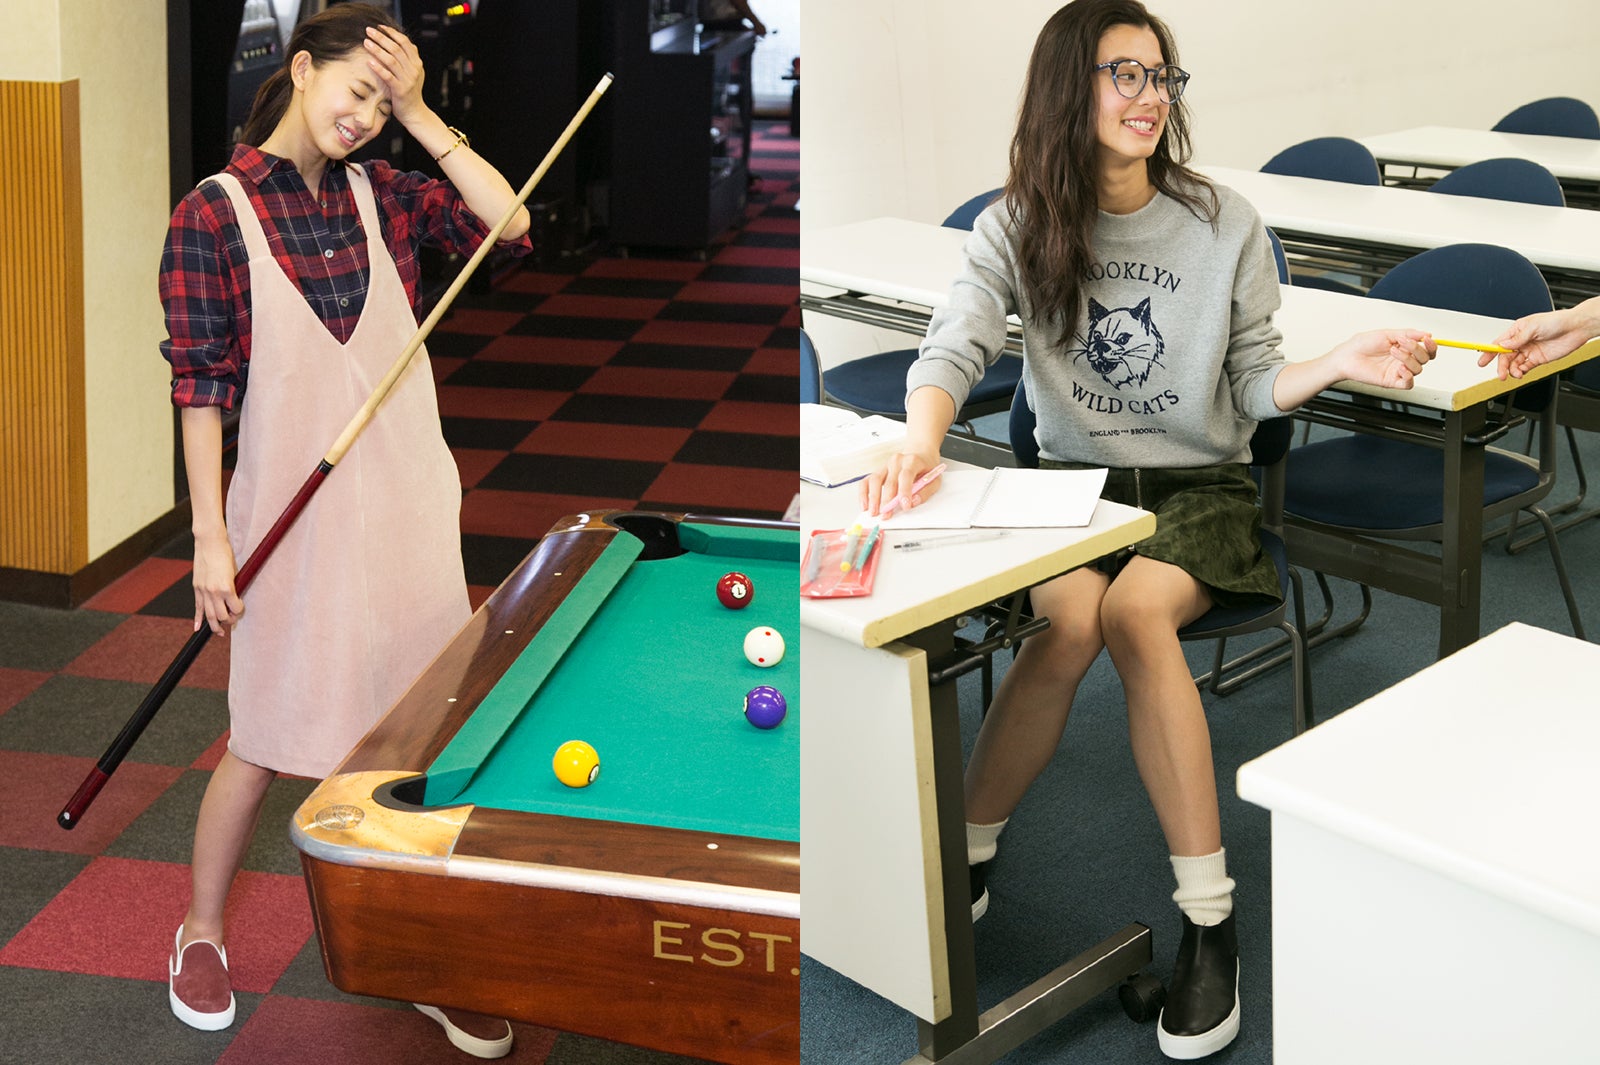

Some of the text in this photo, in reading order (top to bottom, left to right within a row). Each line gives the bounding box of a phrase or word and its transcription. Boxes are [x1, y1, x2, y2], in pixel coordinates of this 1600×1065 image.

[1083, 261, 1181, 293] OOKLYN
[1072, 381, 1180, 415] WILD CATS
[1130, 427, 1167, 435] BROOKLYN
[653, 920, 800, 976] EST.
